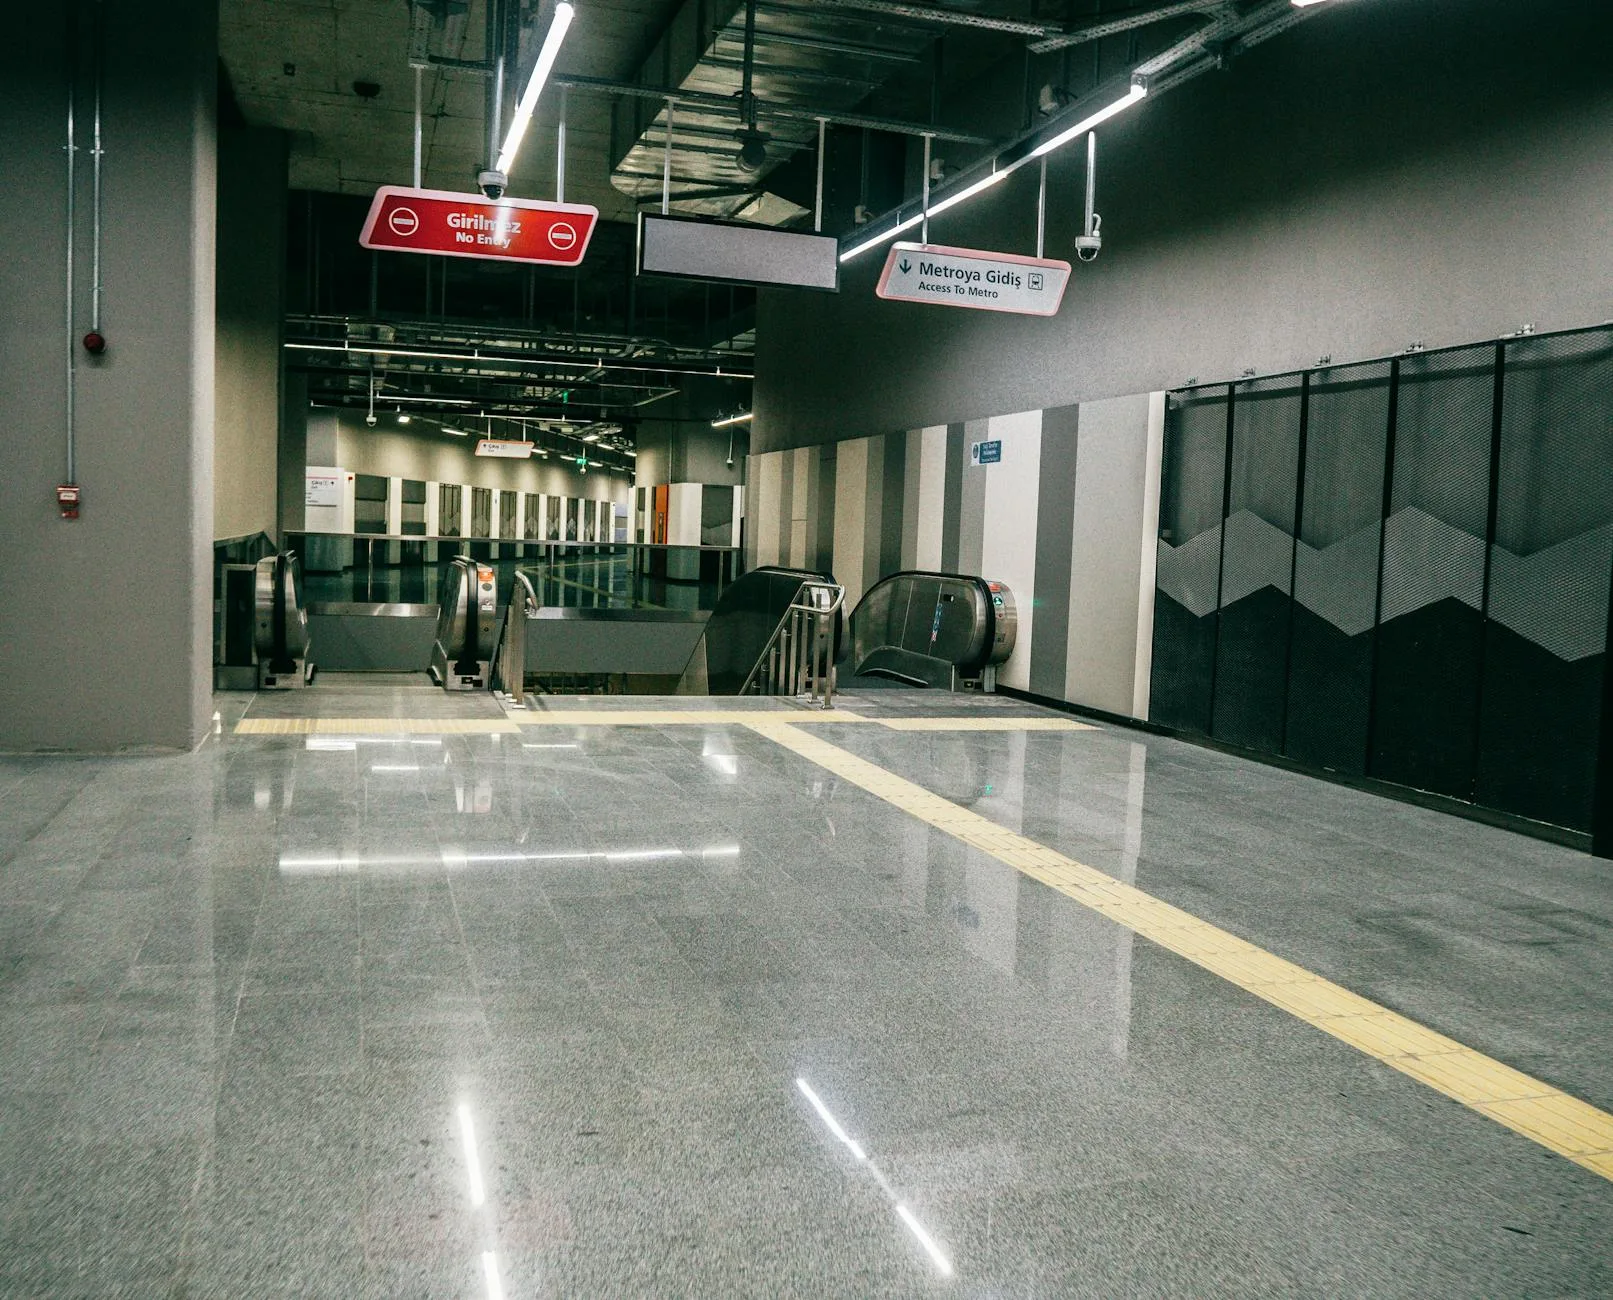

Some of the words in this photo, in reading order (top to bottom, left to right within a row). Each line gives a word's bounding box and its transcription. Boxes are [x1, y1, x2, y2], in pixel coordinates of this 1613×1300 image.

[456, 231, 474, 243] No
[477, 233, 511, 248] Eny
[920, 262, 980, 283] Metroya
[986, 270, 1021, 289] Gidiş
[918, 281, 951, 293] Access
[954, 284, 965, 295] To
[968, 286, 998, 298] Metro
